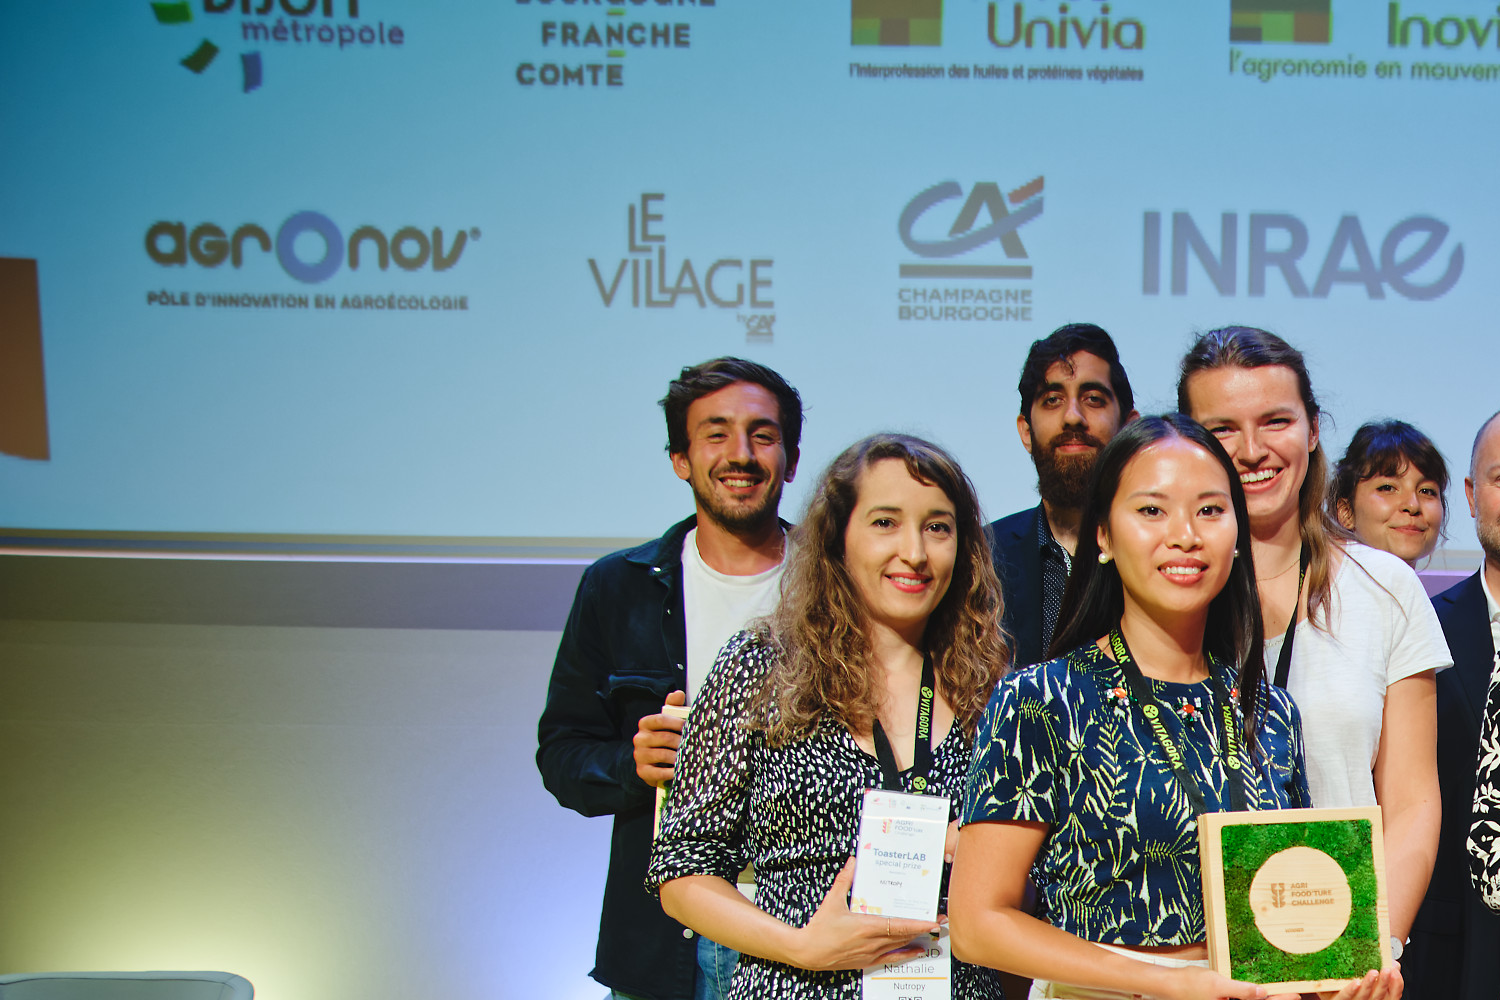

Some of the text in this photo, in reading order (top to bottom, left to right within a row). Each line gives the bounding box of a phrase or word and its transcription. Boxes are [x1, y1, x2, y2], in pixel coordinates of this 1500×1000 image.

[241, 18, 405, 51] métropole
[541, 21, 691, 48] FRANCHE
[987, 2, 1144, 50] Univia
[948, 63, 970, 79] des
[973, 63, 1009, 80] huiles
[1012, 64, 1024, 80] et
[1229, 47, 1367, 82] l'agronomie
[1375, 61, 1402, 78] en
[628, 192, 665, 253] LE
[588, 244, 775, 309] VILLAGE
[147, 288, 469, 311] PÔLE D'INNOVATION EN AGROÉCOLOGIE
[898, 288, 1033, 304] CHAMPAGNE
[898, 305, 1033, 321] BOURGOGNE
[918, 698, 930, 739] VITAGORA
[1222, 705, 1237, 756] VITAGORA
[1150, 718, 1184, 770] VITAGORA
[873, 847, 926, 862] ToasterLAB
[875, 859, 922, 870] special prize
[1291, 898, 1335, 906] CHALLENGE
[884, 963, 935, 974] Nathalie
[893, 982, 926, 992] Nutropy
